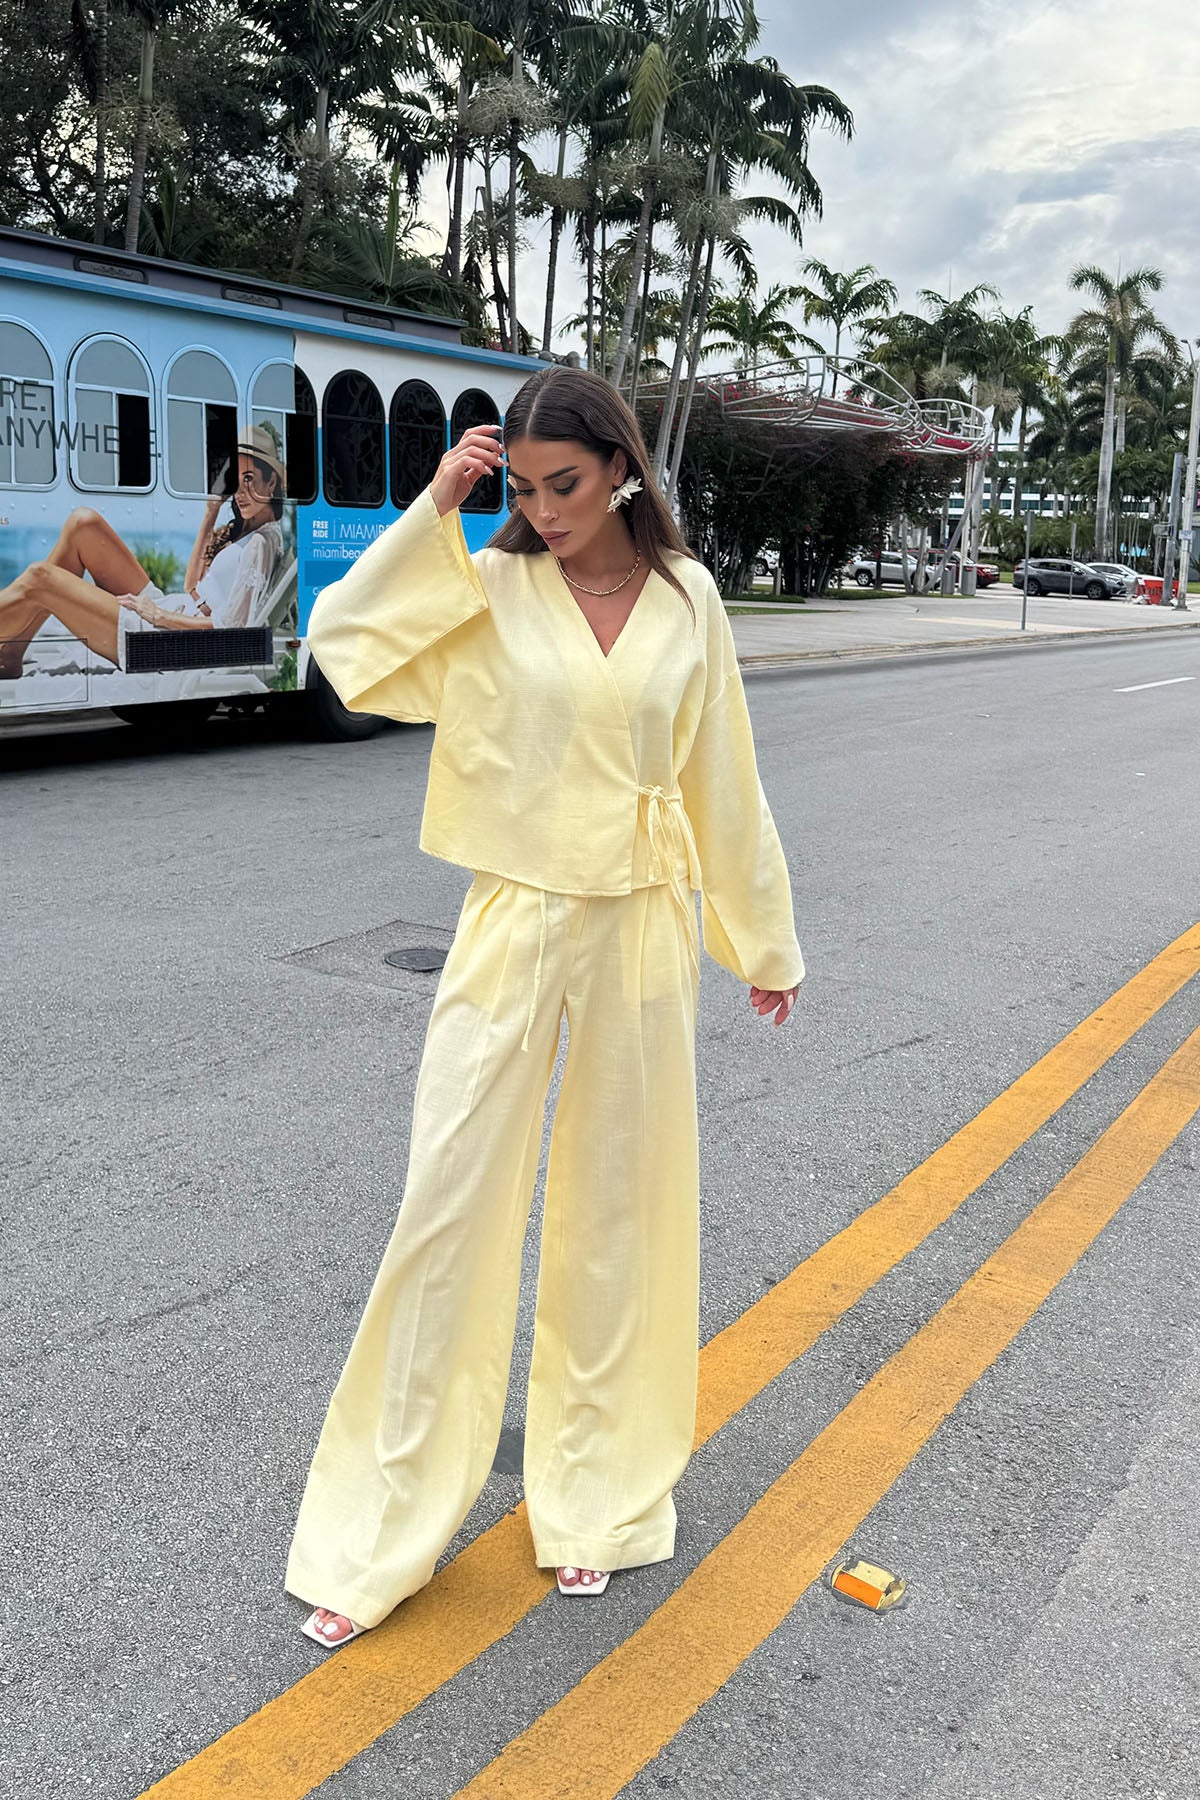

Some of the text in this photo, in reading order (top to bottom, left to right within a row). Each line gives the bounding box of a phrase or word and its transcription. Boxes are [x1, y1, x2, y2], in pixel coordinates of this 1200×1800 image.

[0, 416, 161, 458] NYWHE.
[313, 520, 328, 529] FREE
[313, 530, 328, 538] RIDE
